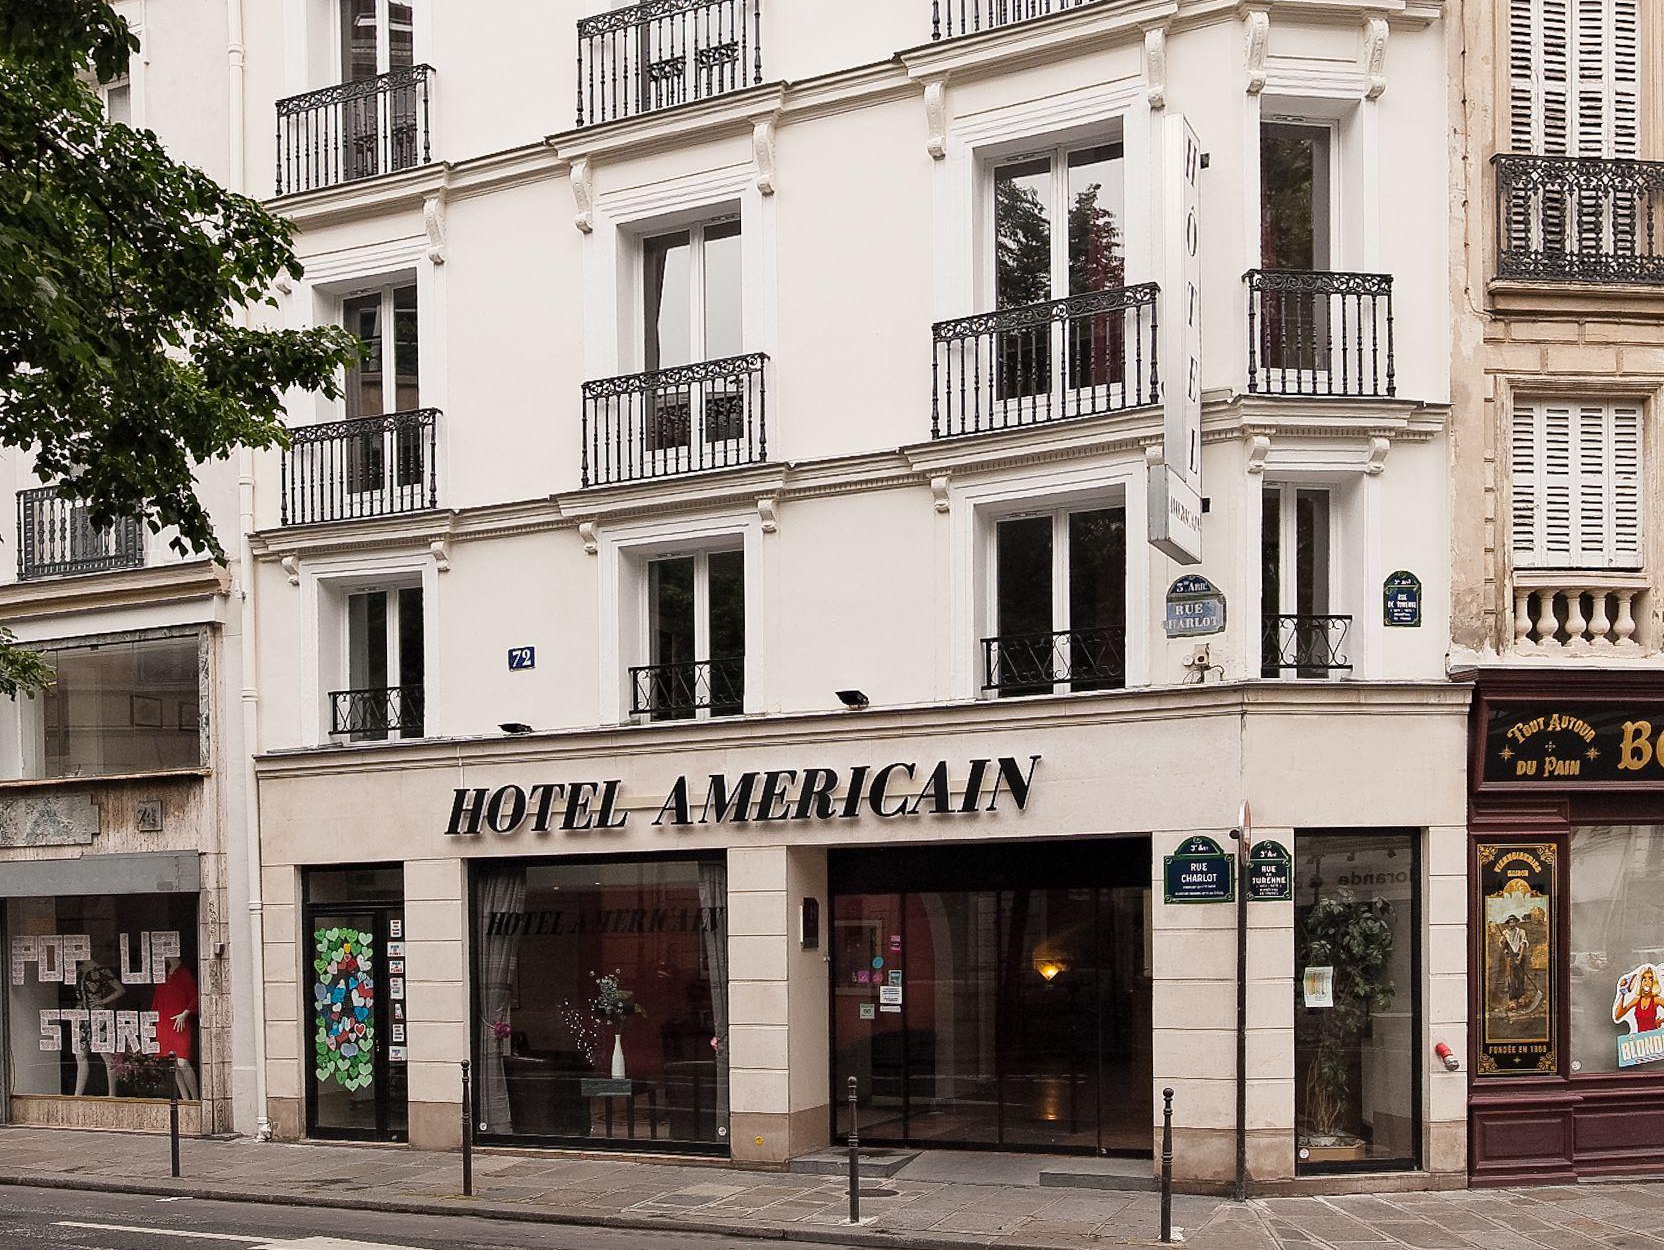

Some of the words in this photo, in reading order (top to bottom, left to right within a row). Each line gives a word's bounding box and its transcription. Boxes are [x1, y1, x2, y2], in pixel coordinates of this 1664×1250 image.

[1175, 602, 1203, 616] RUE
[512, 649, 532, 667] 72
[1617, 720, 1664, 771] B
[444, 779, 631, 835] HOTEL
[651, 754, 1041, 826] AMERICAIN
[1190, 862, 1208, 872] RUE
[1261, 865, 1277, 873] RUE
[1181, 873, 1218, 883] CHARLOT
[1252, 876, 1287, 884] TURENNE
[11, 934, 91, 986] POP
[119, 931, 181, 985] UP
[39, 1009, 161, 1054] STORE
[1621, 1035, 1664, 1061] BLOND
